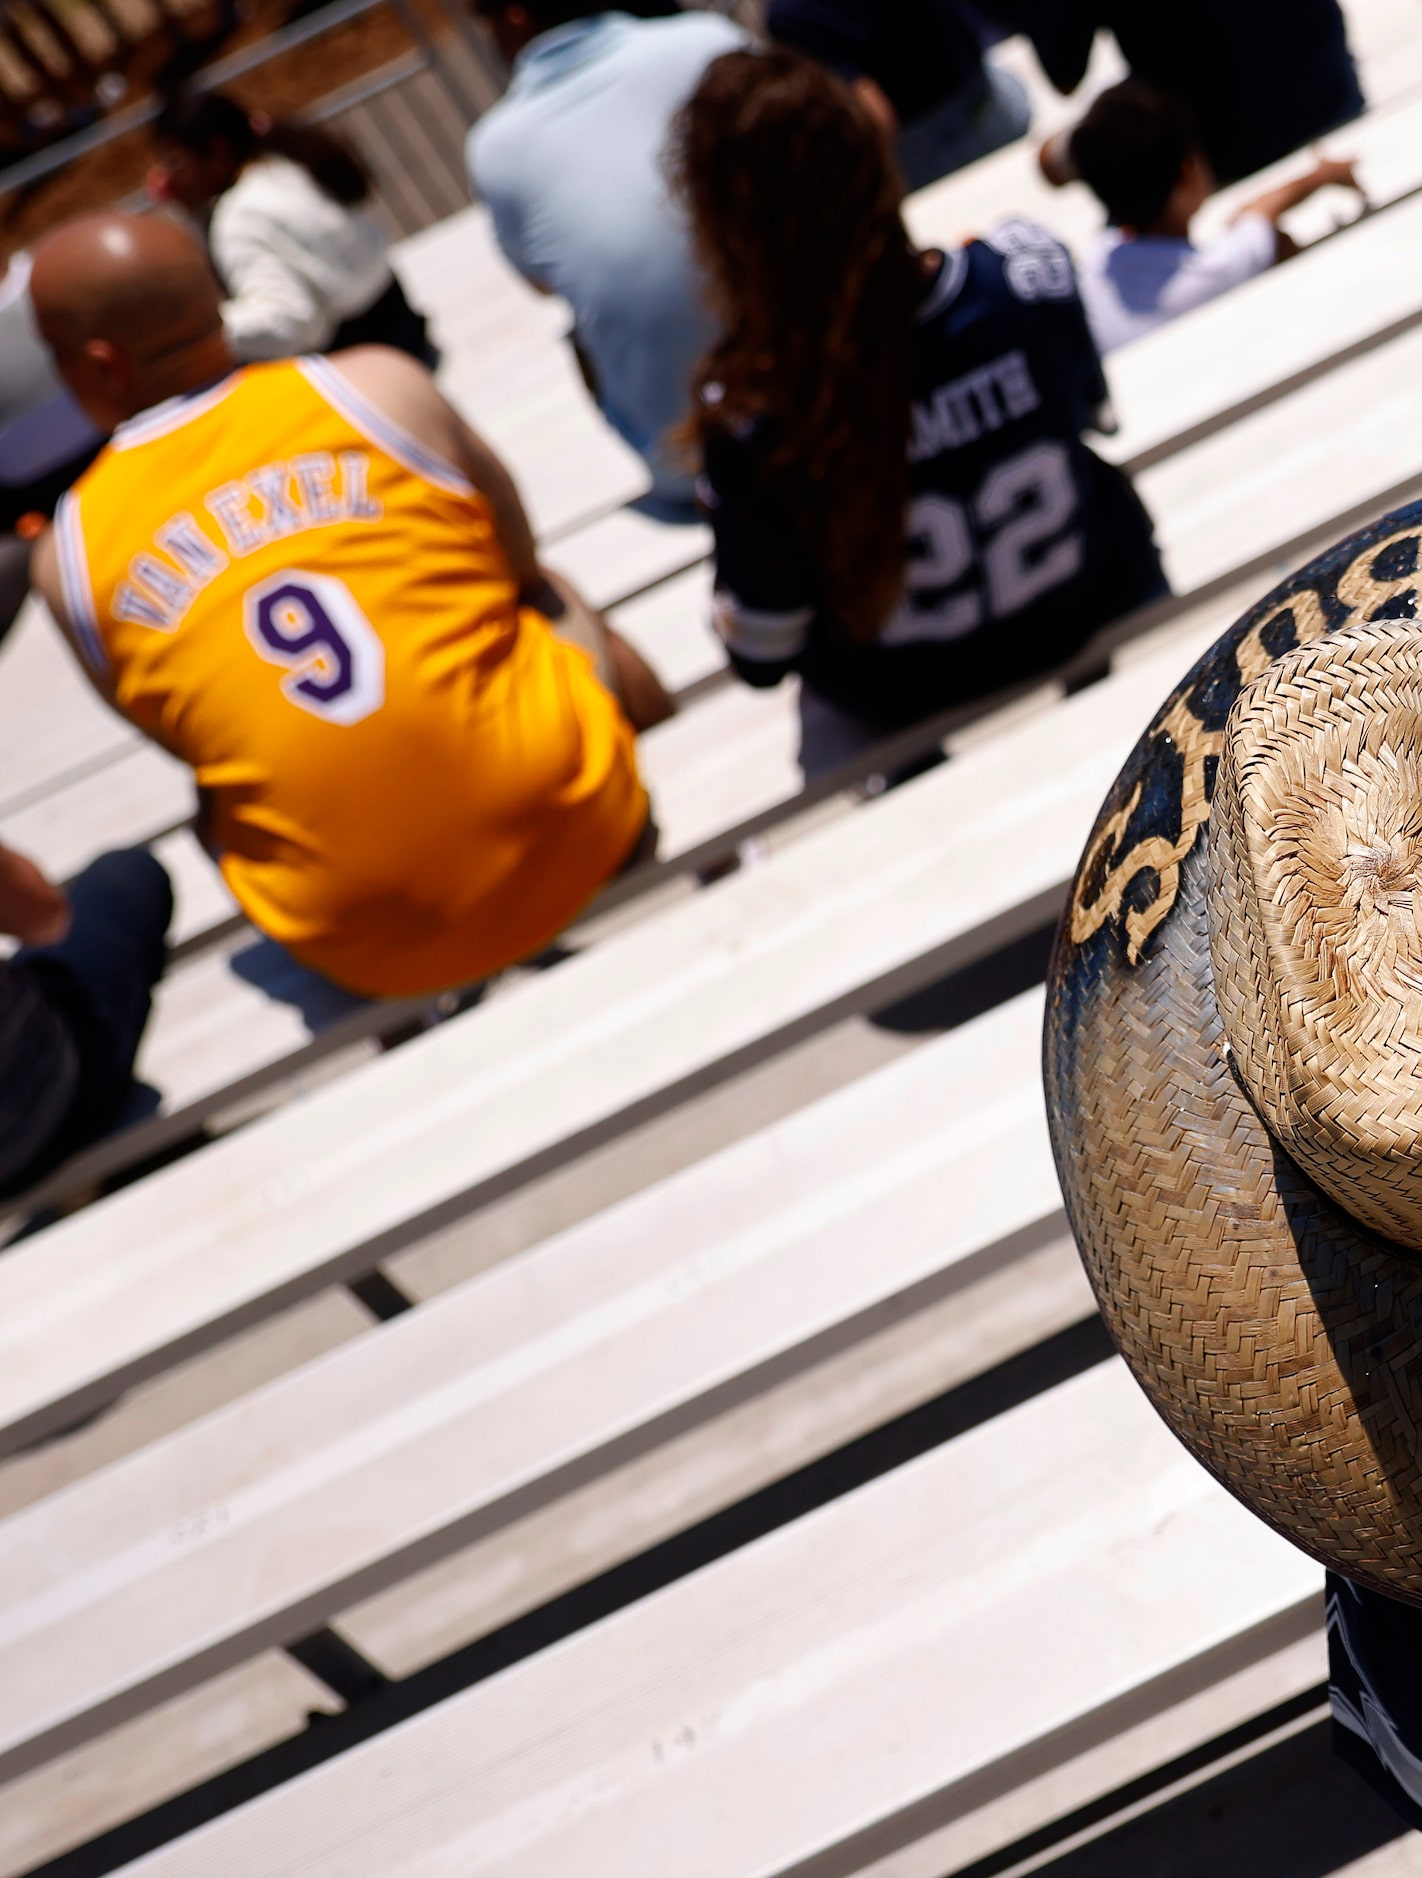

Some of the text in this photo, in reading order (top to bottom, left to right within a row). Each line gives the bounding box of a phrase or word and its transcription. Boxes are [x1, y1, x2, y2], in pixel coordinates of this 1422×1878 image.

[906, 350, 1041, 463] MITH
[112, 450, 384, 634] VAN EXEL
[880, 439, 1084, 648] 22
[245, 570, 382, 724] 9
